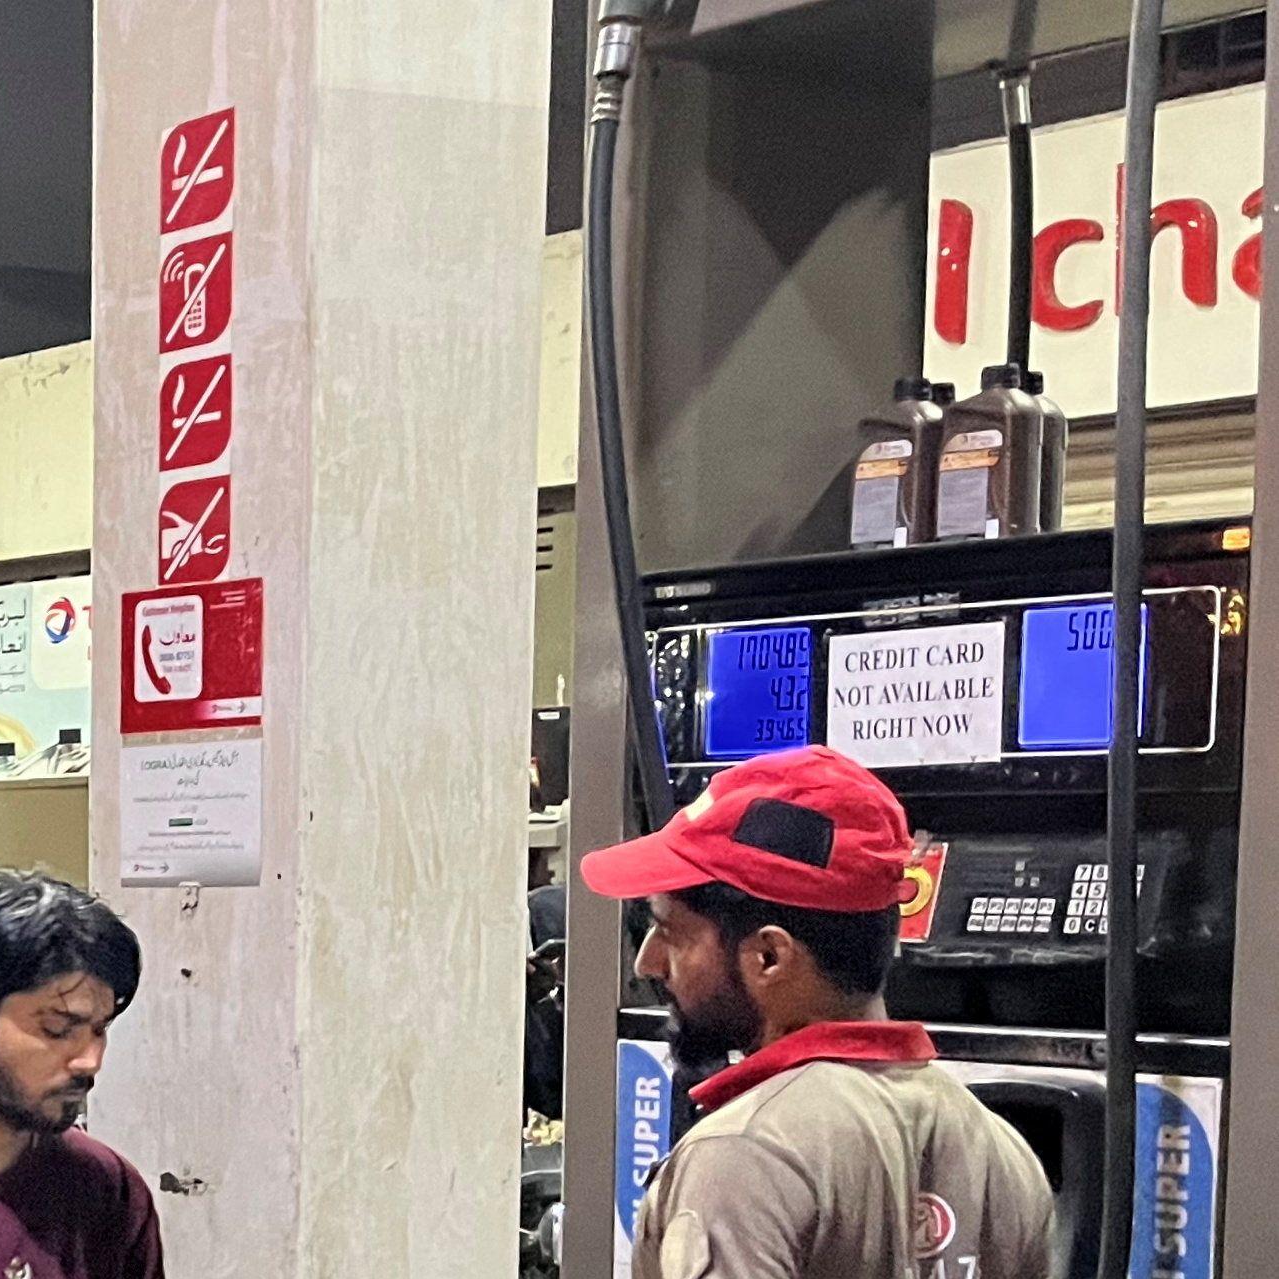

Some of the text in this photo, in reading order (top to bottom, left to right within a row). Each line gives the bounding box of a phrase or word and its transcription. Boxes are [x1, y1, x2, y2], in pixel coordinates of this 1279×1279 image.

[845, 642, 984, 673] CREDIT CARD
[833, 676, 994, 709] NOT AVAILABLE
[852, 713, 974, 740] RIGHT NOW
[632, 1076, 661, 1188] SUPER
[1153, 1123, 1191, 1258] SUPER
